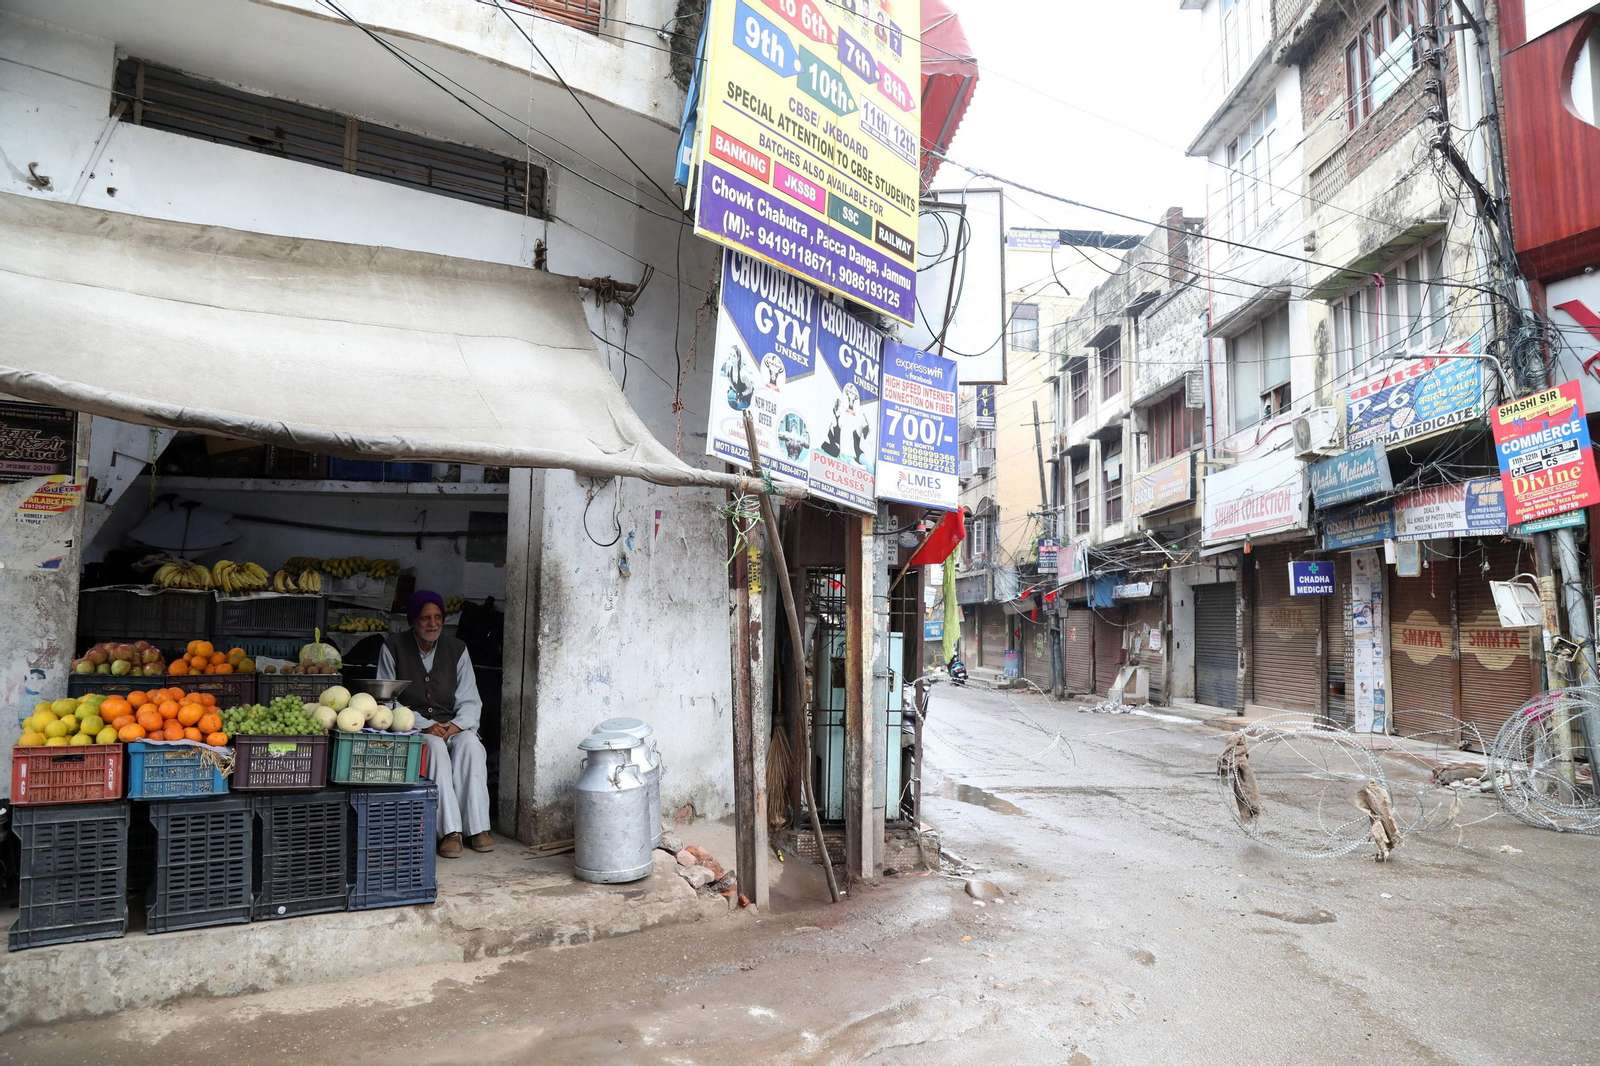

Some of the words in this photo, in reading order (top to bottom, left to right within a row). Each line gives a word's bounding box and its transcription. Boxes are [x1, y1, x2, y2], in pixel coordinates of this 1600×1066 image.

[801, 4, 828, 43] 6th
[745, 16, 785, 68] 9th
[845, 38, 871, 78] 7th
[809, 62, 847, 113] 10th
[883, 72, 907, 108] 8th
[727, 81, 775, 124] SPECIAL
[777, 113, 835, 161] ATTENTION
[837, 149, 849, 170] TO
[851, 157, 873, 184] CBSE
[875, 171, 916, 212] STUDENTS
[823, 120, 869, 161] JKBOARD
[894, 125, 916, 157] 12th
[715, 135, 767, 175] BANKING
[759, 133, 801, 168] BATCHES
[803, 159, 825, 182] ALSO
[826, 175, 868, 208] AVAILABLE
[869, 200, 884, 217] FOR
[784, 175, 817, 202] JKSSB
[842, 205, 860, 226] SSC
[712, 175, 754, 211] Chowk
[816, 228, 847, 258] Pacca
[849, 243, 879, 274] Danga,
[881, 262, 912, 291] Jammu
[878, 227, 912, 256] RAILWAY
[730, 251, 816, 324] CHOUDHARY
[838, 266, 901, 309] 9086193125
[754, 301, 812, 356] GYM
[821, 298, 883, 362] CHOUDHARY
[774, 342, 810, 368] UNISEX
[838, 343, 880, 387] GYM
[853, 374, 880, 396] UNISEX
[885, 375, 901, 389] HIGH
[901, 380, 922, 396] SPEED
[922, 387, 954, 404] INTERNET
[909, 372, 933, 386] facebook
[1448, 377, 1478, 396] (PILES)
[754, 395, 765, 411] NEW
[884, 387, 924, 409] CONNECTION
[925, 400, 934, 411] ON
[935, 402, 955, 415] FIBER
[1349, 383, 1410, 426] P-6
[1500, 397, 1537, 418] SHASHI
[1540, 390, 1558, 404] SIR
[1536, 406, 1550, 416] NAME
[1550, 402, 1572, 416] COMMERCE
[758, 412, 773, 428] OFFER
[886, 408, 954, 447] 700/-
[909, 409, 930, 419] STARTING
[930, 414, 943, 422] FROM
[1403, 406, 1473, 439] MEDICATE
[715, 440, 730, 453] MOTI
[902, 440, 914, 448] PER
[914, 441, 935, 452] MONTH
[1501, 419, 1582, 455] COMMERCE
[0, 448, 67, 462] estival
[1512, 467, 1526, 477] CA
[1546, 457, 1559, 467] CS
[33, 464, 52, 472] 2019
[813, 452, 848, 474] POWER
[850, 467, 876, 486] YOGA
[824, 469, 866, 492] CLASSES
[1312, 465, 1338, 496] Chadha
[1337, 457, 1376, 483] Medicate
[907, 472, 942, 490] LMES
[1511, 465, 1583, 497] Divine
[1526, 488, 1554, 499] COMMERCE
[1554, 481, 1580, 492] ACADEMY
[1241, 489, 1291, 521] COLLECTION
[1320, 494, 1342, 505] Chemists
[1347, 485, 1373, 500] Druggists
[1412, 487, 1437, 508] GLASS
[1437, 483, 1466, 504] HOUSE
[1515, 505, 1535, 516] Afghana
[1555, 496, 1571, 504] Pacca
[1571, 491, 1589, 501] Danga
[1414, 516, 1424, 524] KINDS
[1431, 513, 1446, 522] PHOTOS
[1446, 511, 1463, 521] FRAMES,
[1423, 506, 1435, 514] DEALS
[1326, 519, 1353, 536] CHADHA
[1353, 511, 1390, 530] MEDICATE
[1414, 522, 1434, 532] MOULDING
[1437, 521, 1454, 530] POSTERS
[1431, 531, 1449, 540] JAMMU
[1525, 523, 1542, 531] PACCA
[1561, 517, 1581, 525] JAMMU
[1297, 585, 1333, 594] MEDICATE
[1299, 576, 1330, 584] CHADHA
[1402, 629, 1444, 648] SMMTA
[1469, 628, 1521, 649] SMMTA
